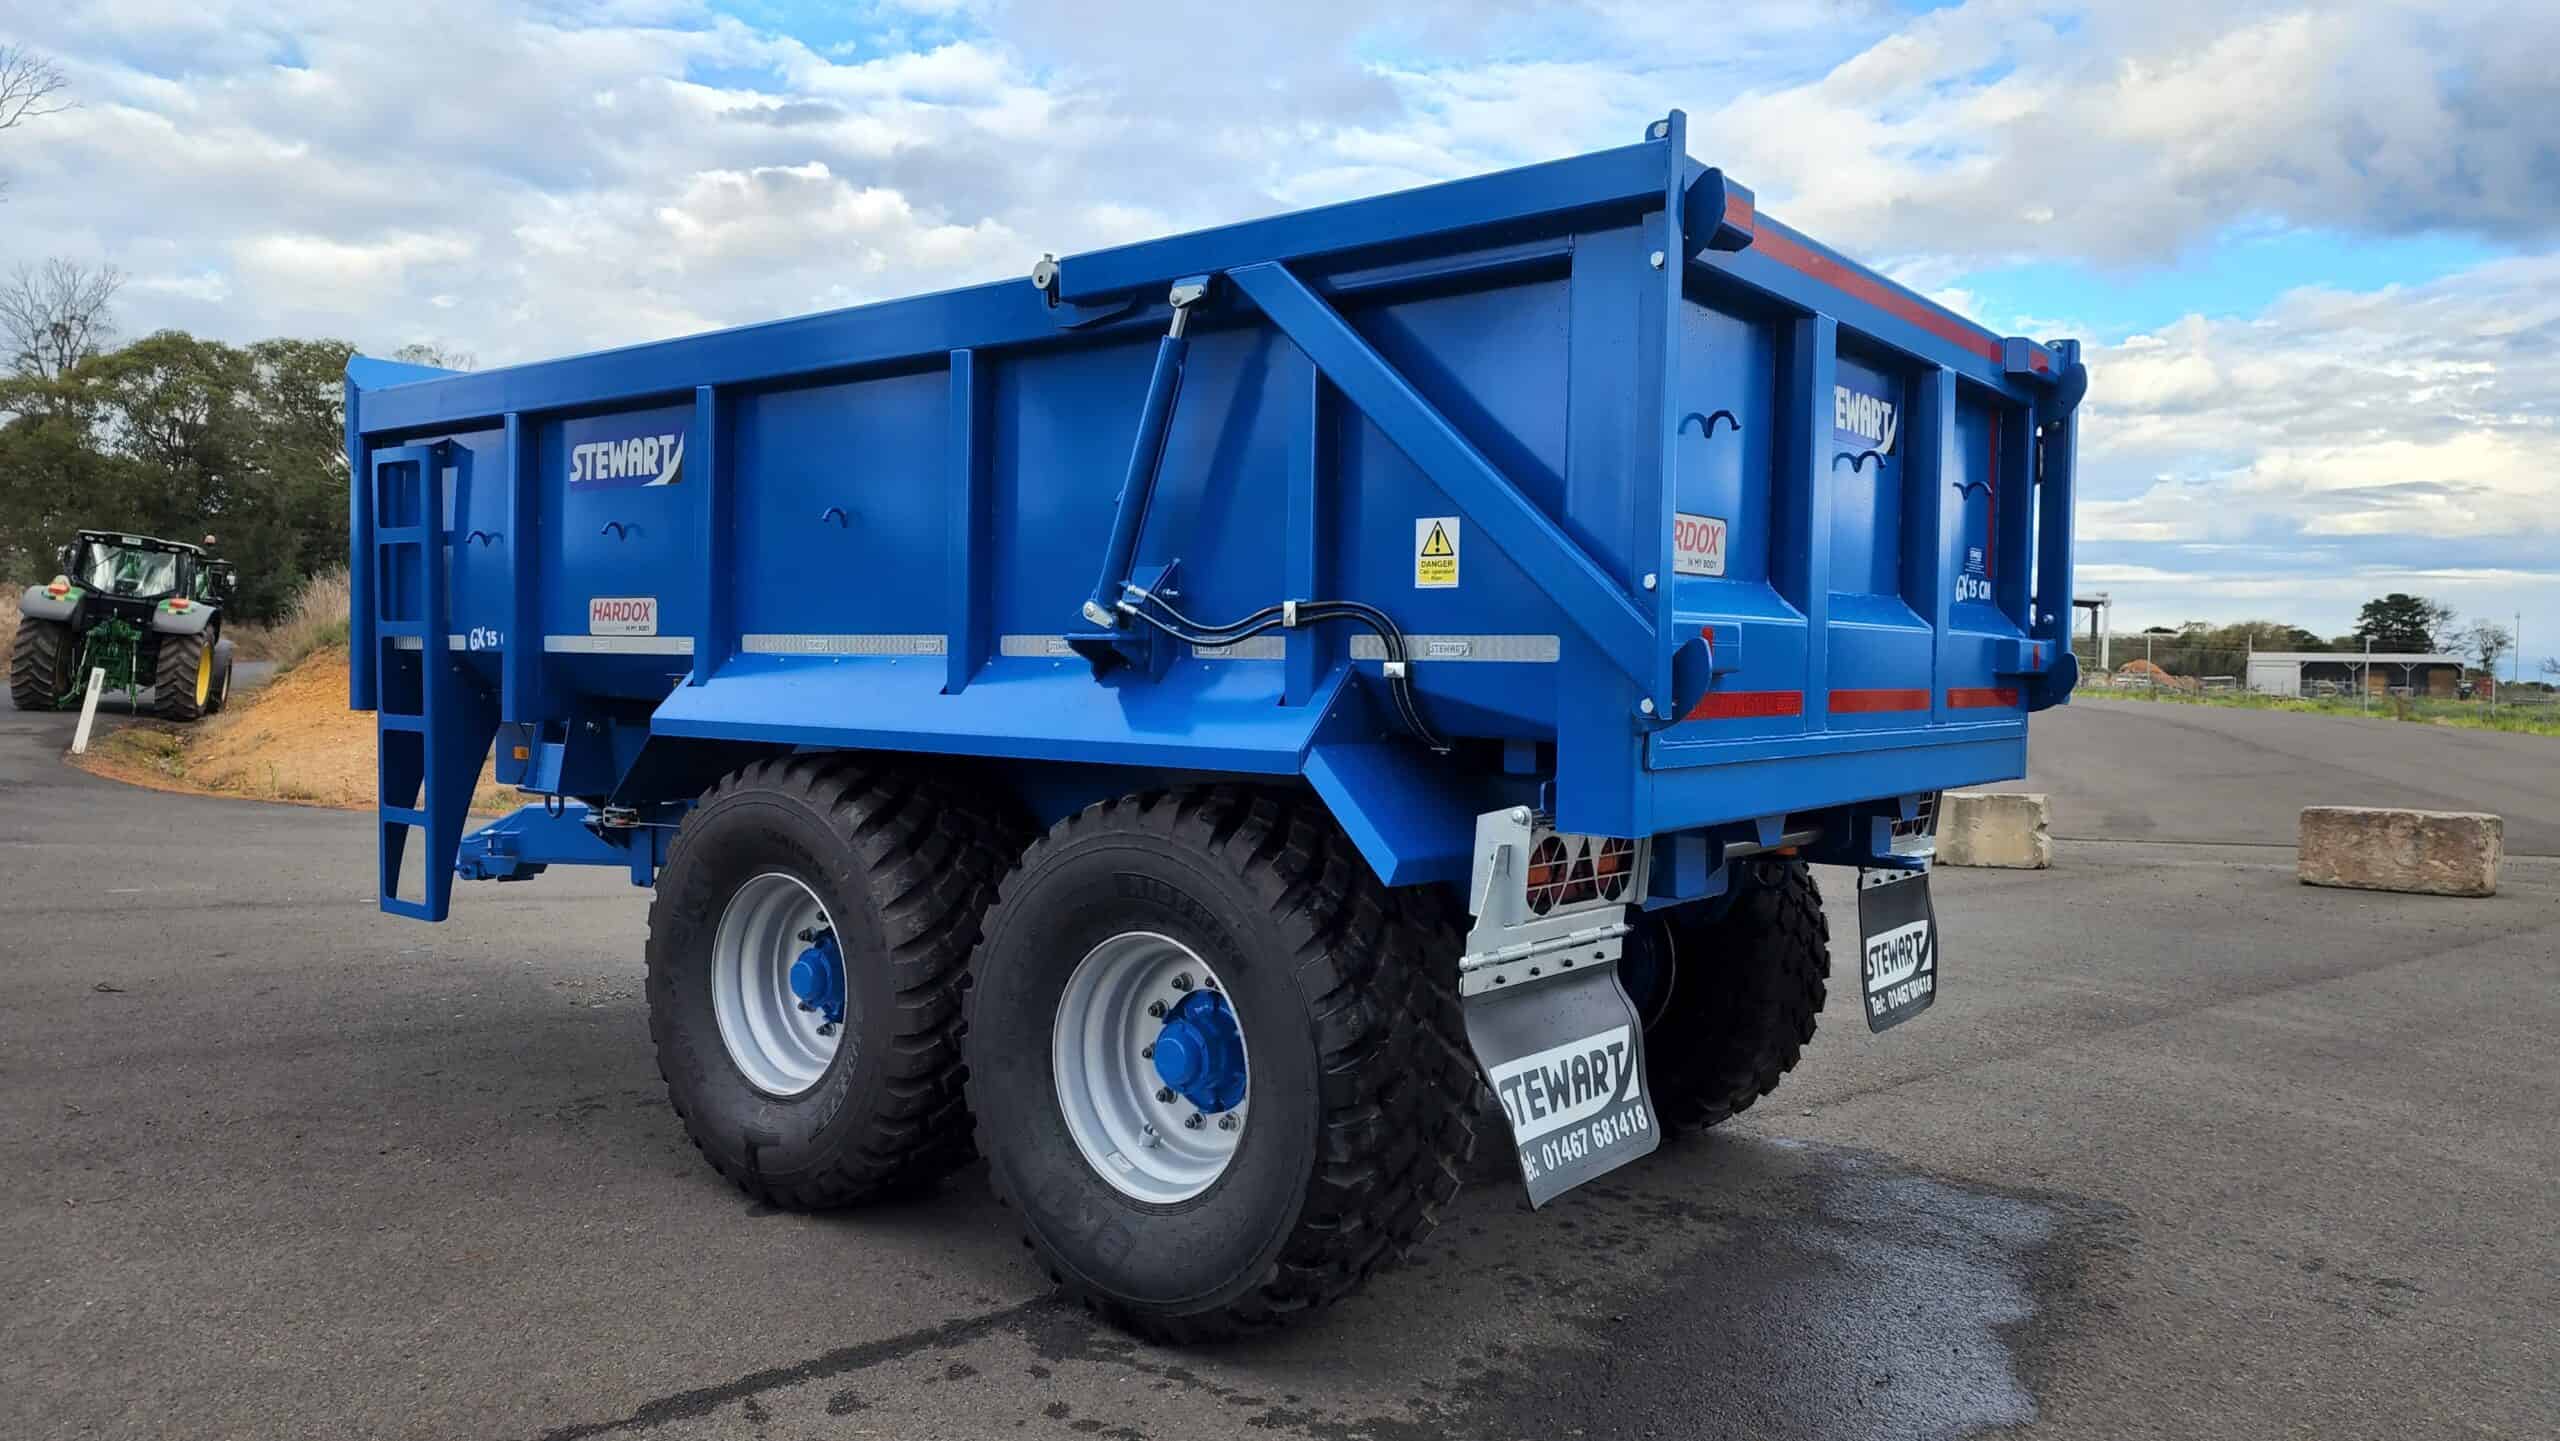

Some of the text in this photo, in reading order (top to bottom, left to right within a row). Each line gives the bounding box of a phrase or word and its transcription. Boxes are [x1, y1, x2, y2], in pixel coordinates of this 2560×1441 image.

[1833, 384, 1898, 454] EWART
[569, 431, 685, 487] STEWART
[1675, 519, 1720, 556] RDOX
[1421, 559, 1453, 568] DANGER
[1955, 573, 1969, 602] GX
[1969, 579, 1978, 599] 15
[592, 601, 651, 622] HARDOX
[470, 626, 486, 651] GX
[486, 630, 497, 647] 15
[1867, 929, 1931, 981] STEWART
[1499, 1036, 1634, 1130] STEWART
[1521, 1104, 1648, 1182] el: 01467 681418
